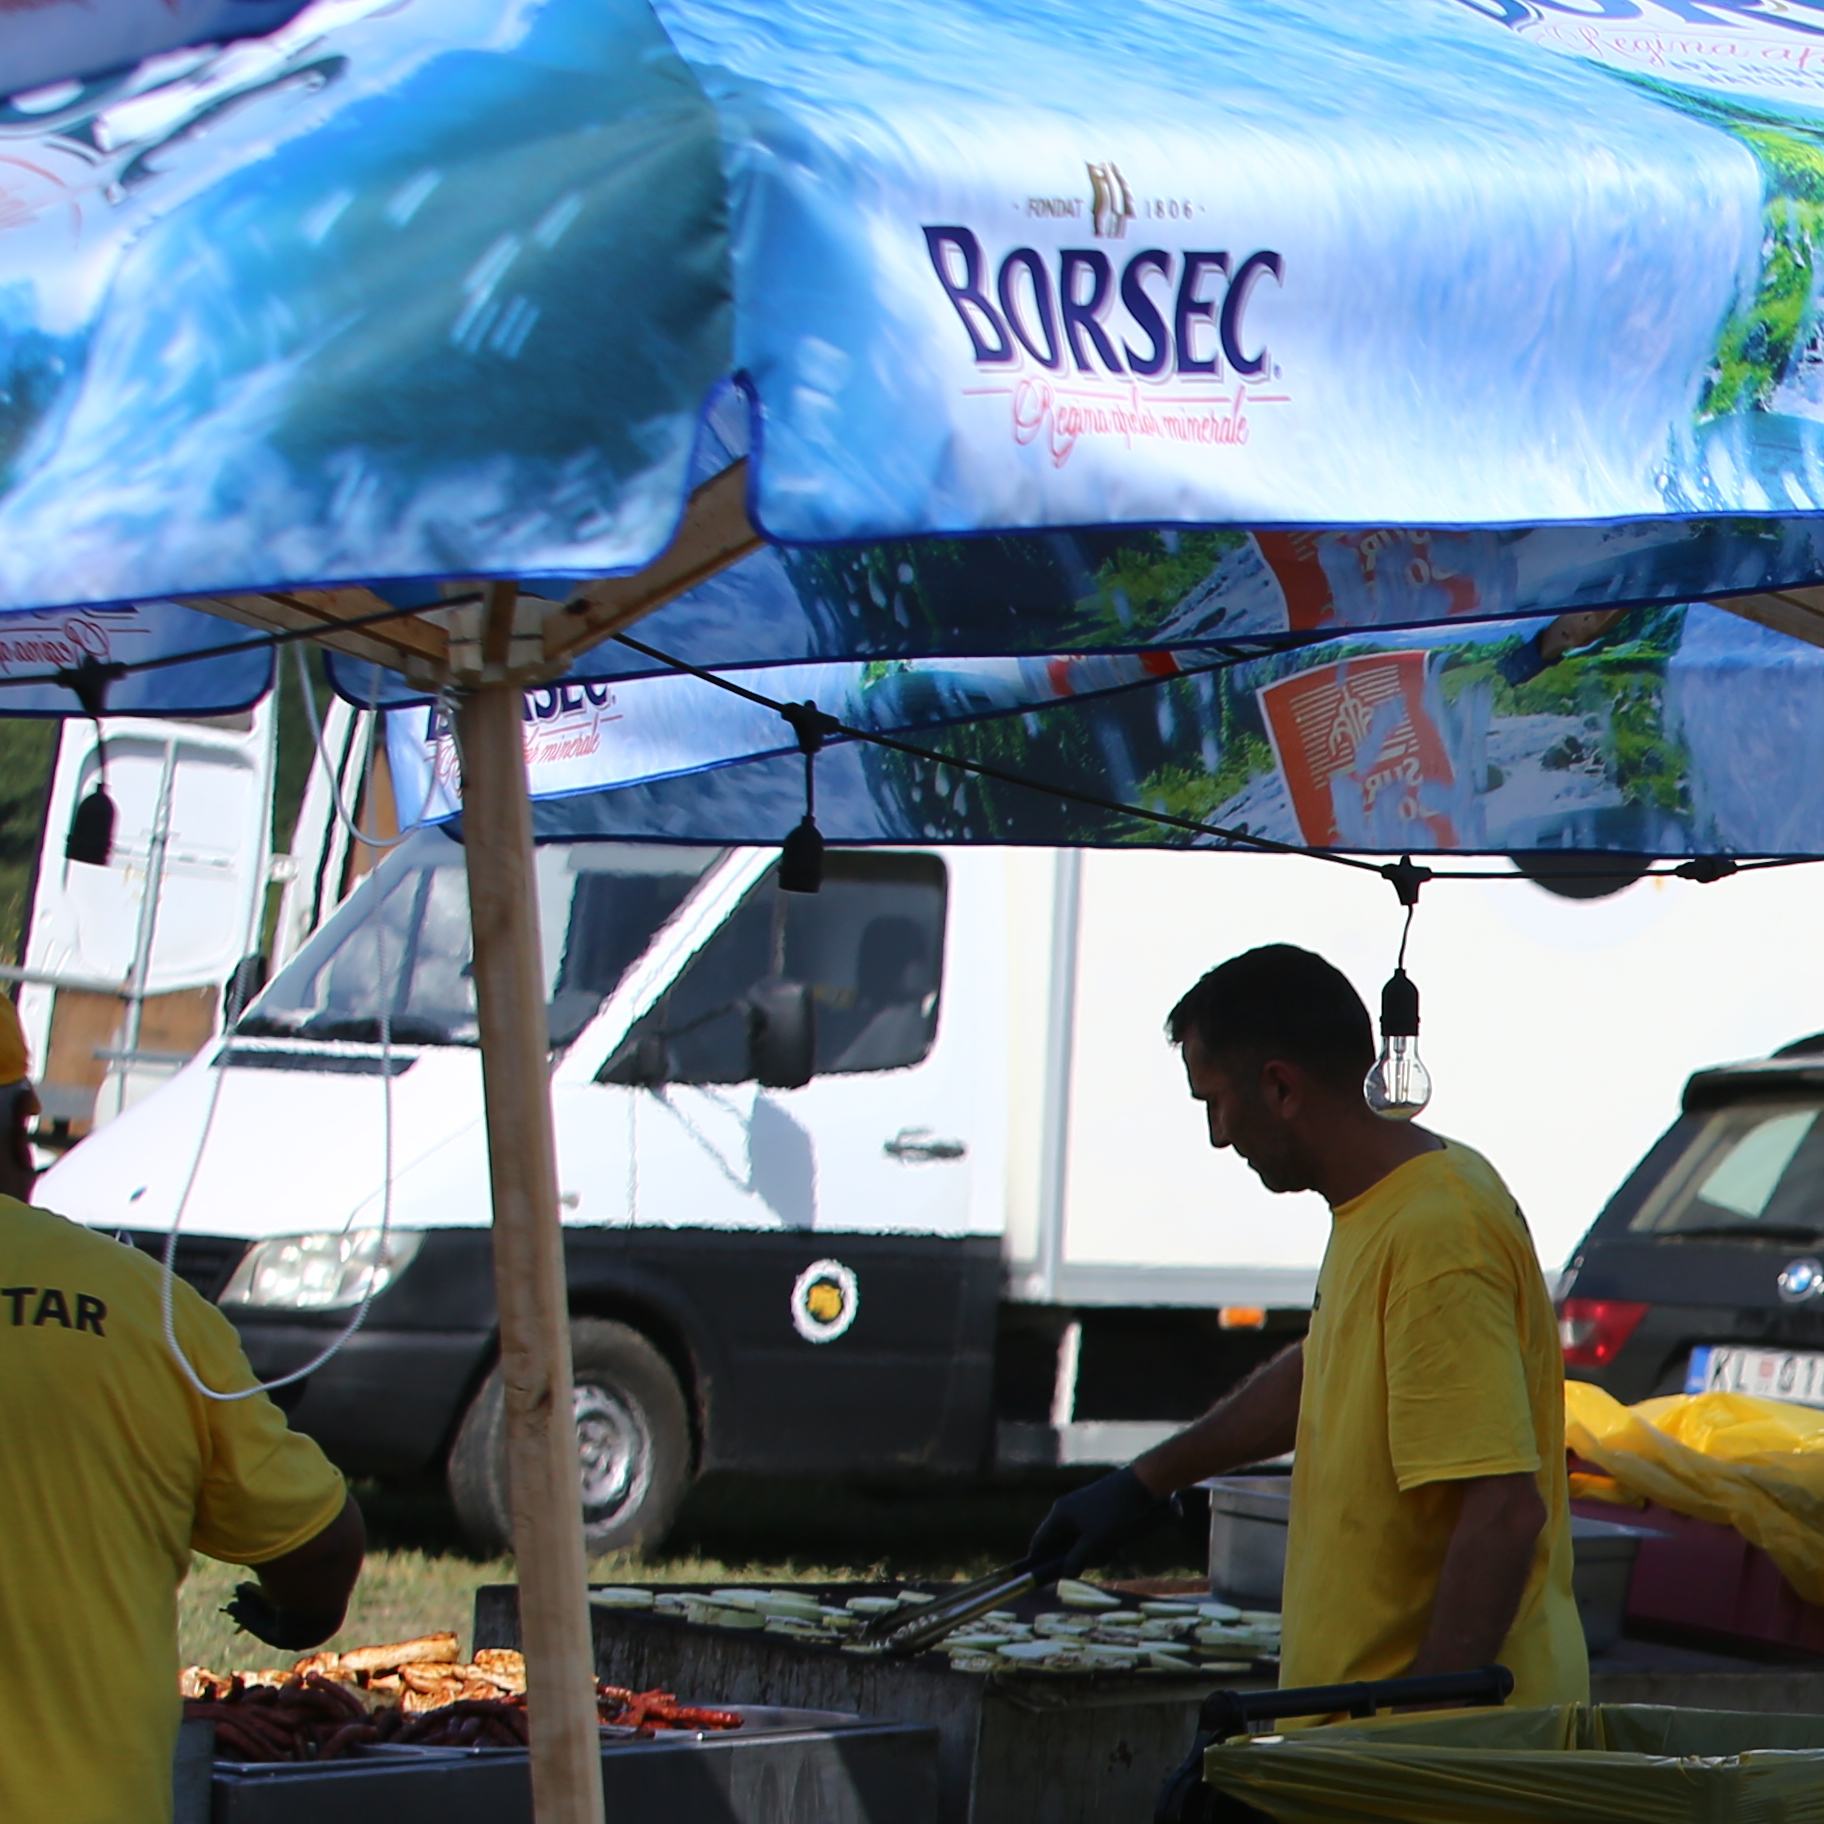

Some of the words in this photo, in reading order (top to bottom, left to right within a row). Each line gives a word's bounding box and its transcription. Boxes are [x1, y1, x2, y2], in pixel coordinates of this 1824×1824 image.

[921, 225, 1284, 383] BORSEC
[1162, 384, 1249, 445] minerale
[0, 1286, 107, 1338] TAR
